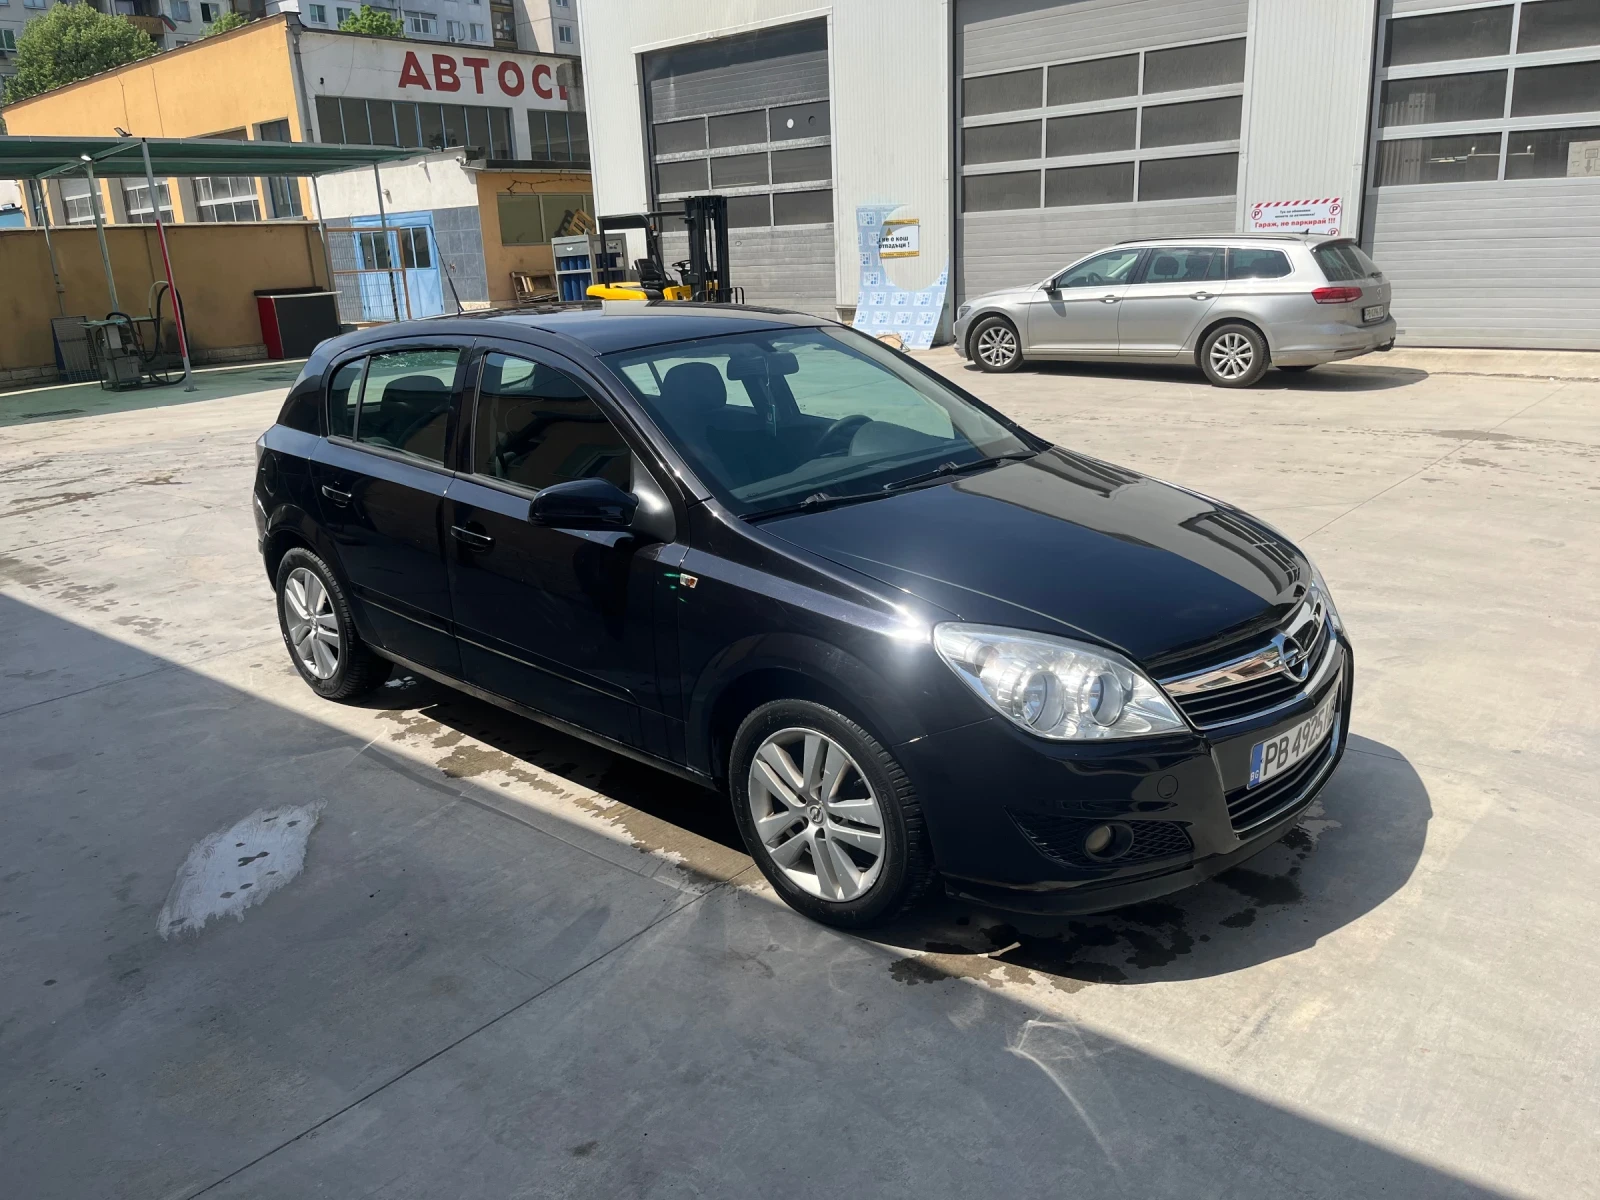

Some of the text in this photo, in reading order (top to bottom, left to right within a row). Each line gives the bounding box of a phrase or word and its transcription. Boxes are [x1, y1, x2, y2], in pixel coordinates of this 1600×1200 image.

[398, 51, 568, 100] АВТОС
[1291, 218, 1326, 226] паркирай
[1263, 736, 1290, 776] PB
[1291, 707, 1325, 758] 4925
[1250, 769, 1260, 782] BG
